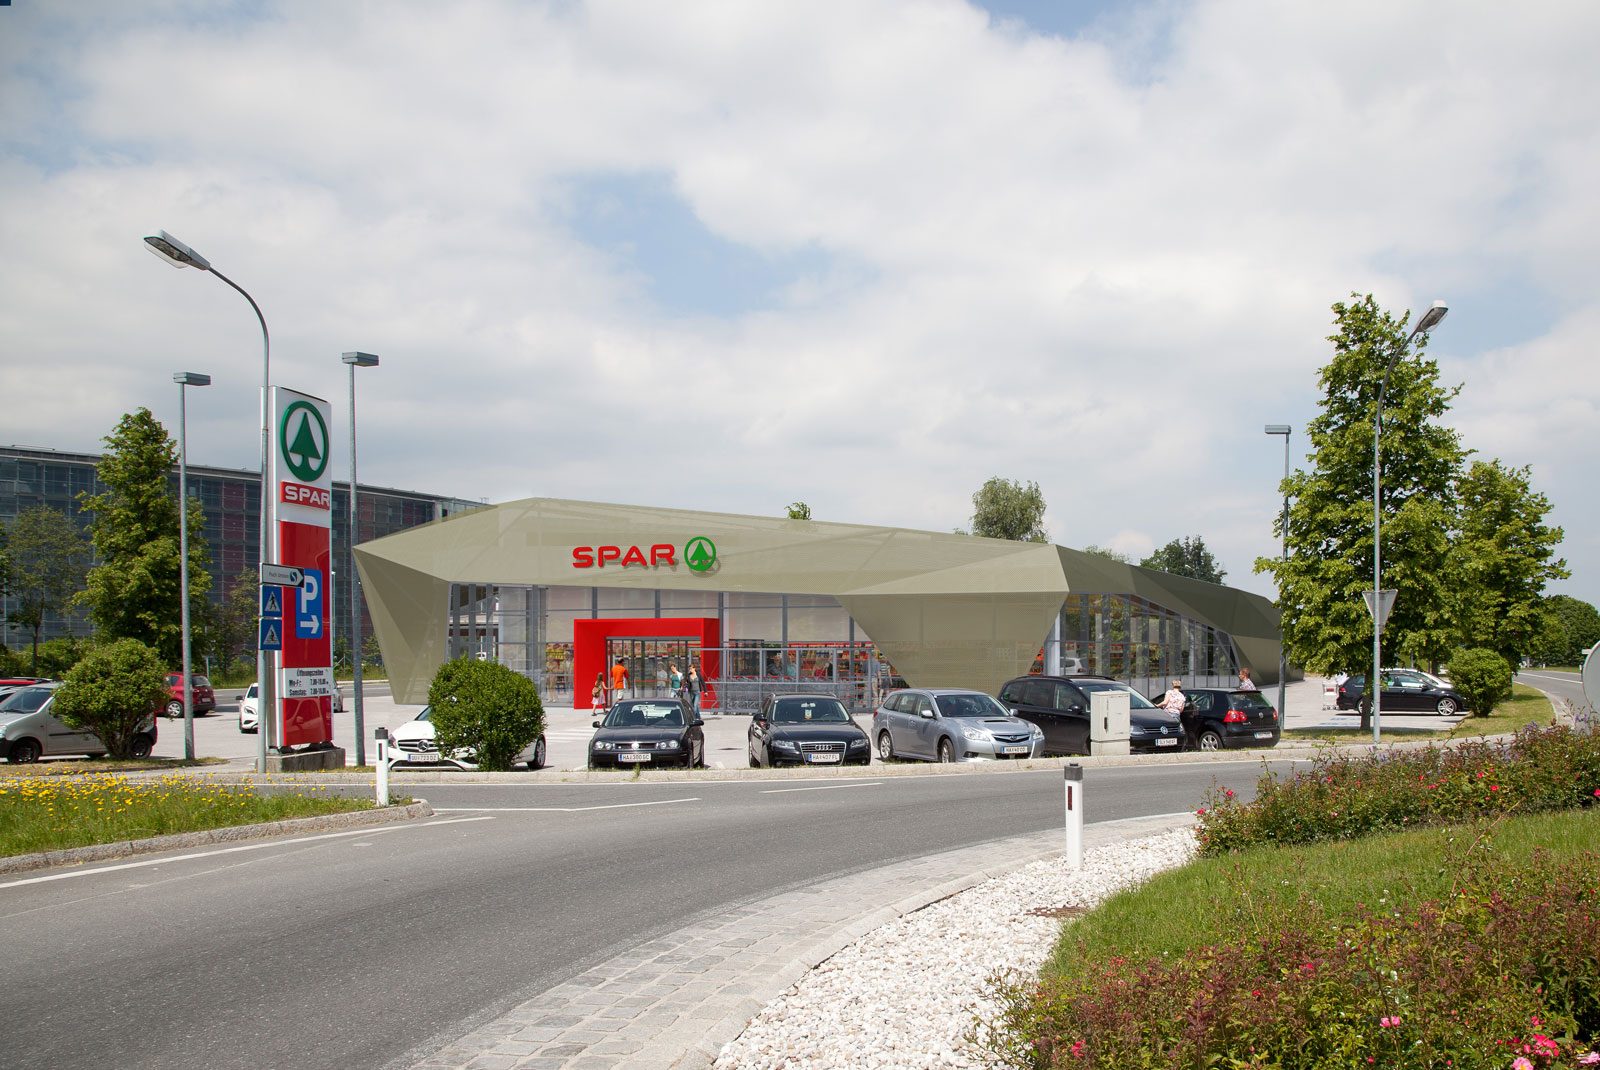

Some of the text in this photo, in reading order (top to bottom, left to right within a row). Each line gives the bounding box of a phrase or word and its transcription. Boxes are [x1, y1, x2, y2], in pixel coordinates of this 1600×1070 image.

[285, 485, 330, 507] SPAR
[572, 543, 675, 568] SPAR
[301, 575, 319, 614] P
